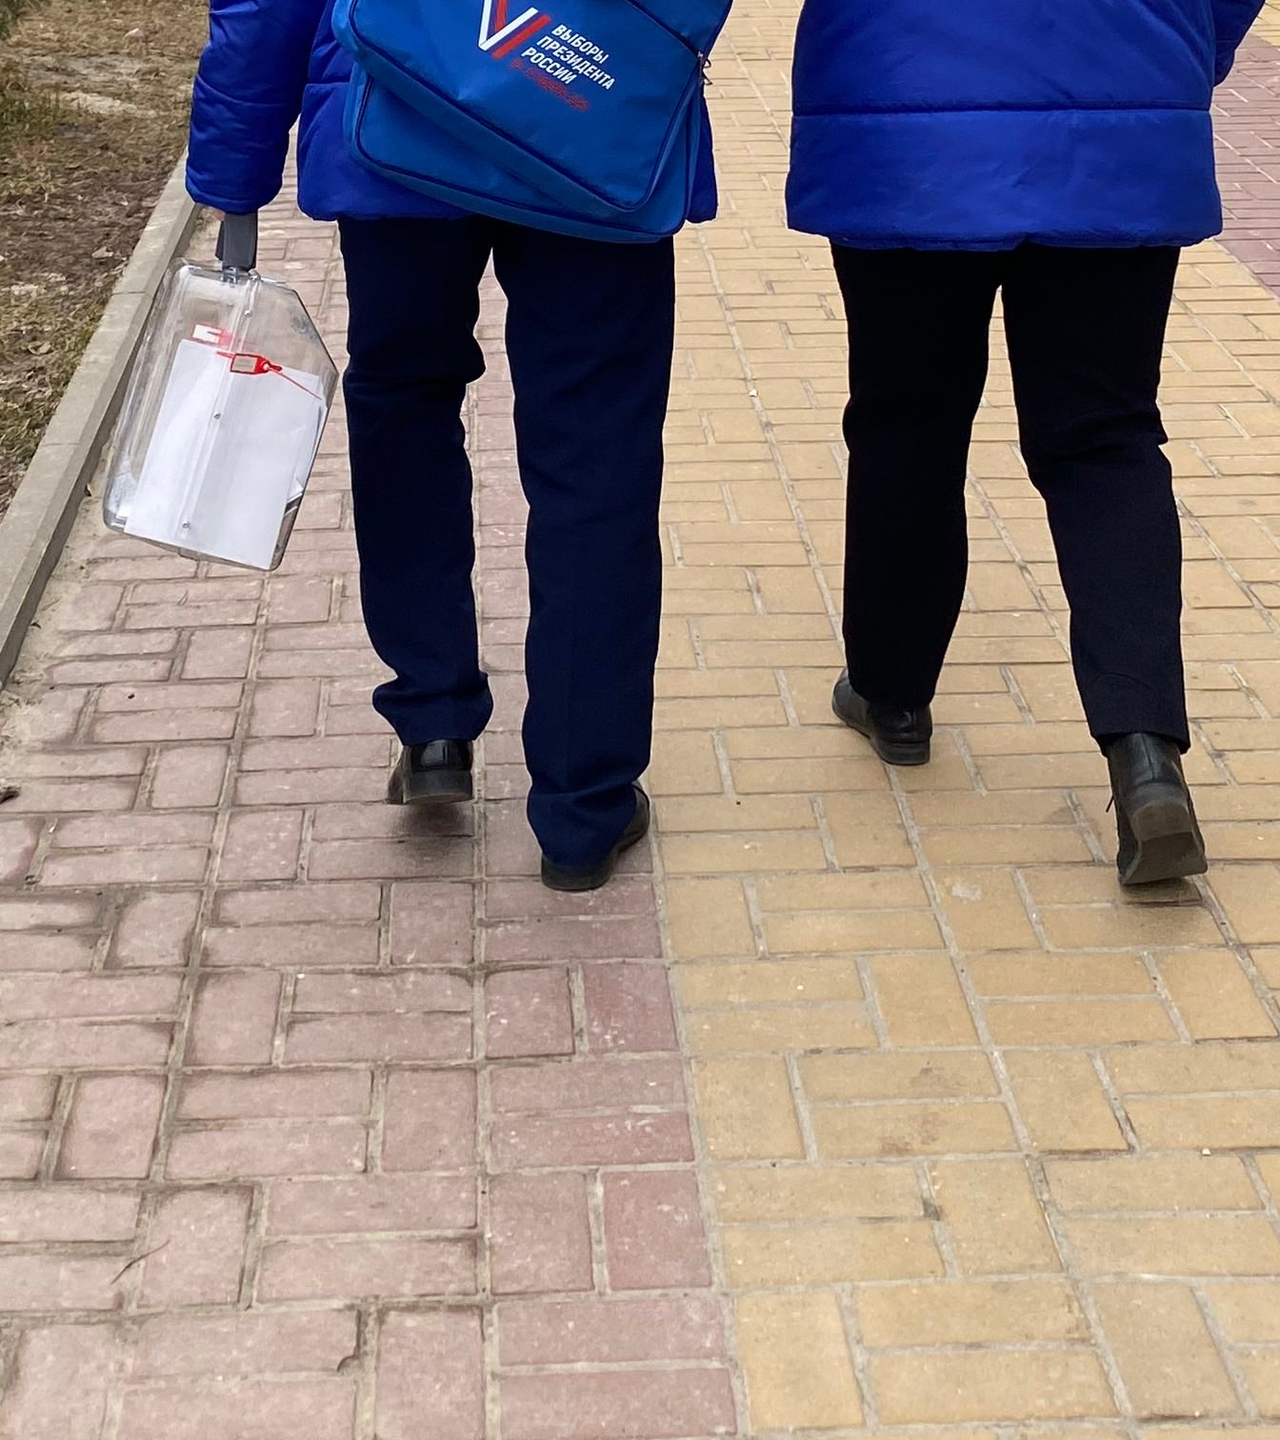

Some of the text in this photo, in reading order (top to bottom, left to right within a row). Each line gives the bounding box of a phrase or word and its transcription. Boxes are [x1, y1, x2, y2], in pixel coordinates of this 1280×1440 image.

[536, 35, 616, 90] ПРЕЗИДЕНТА
[551, 24, 609, 64] ВЫБОРЫ
[521, 47, 578, 84] РОССИИ
